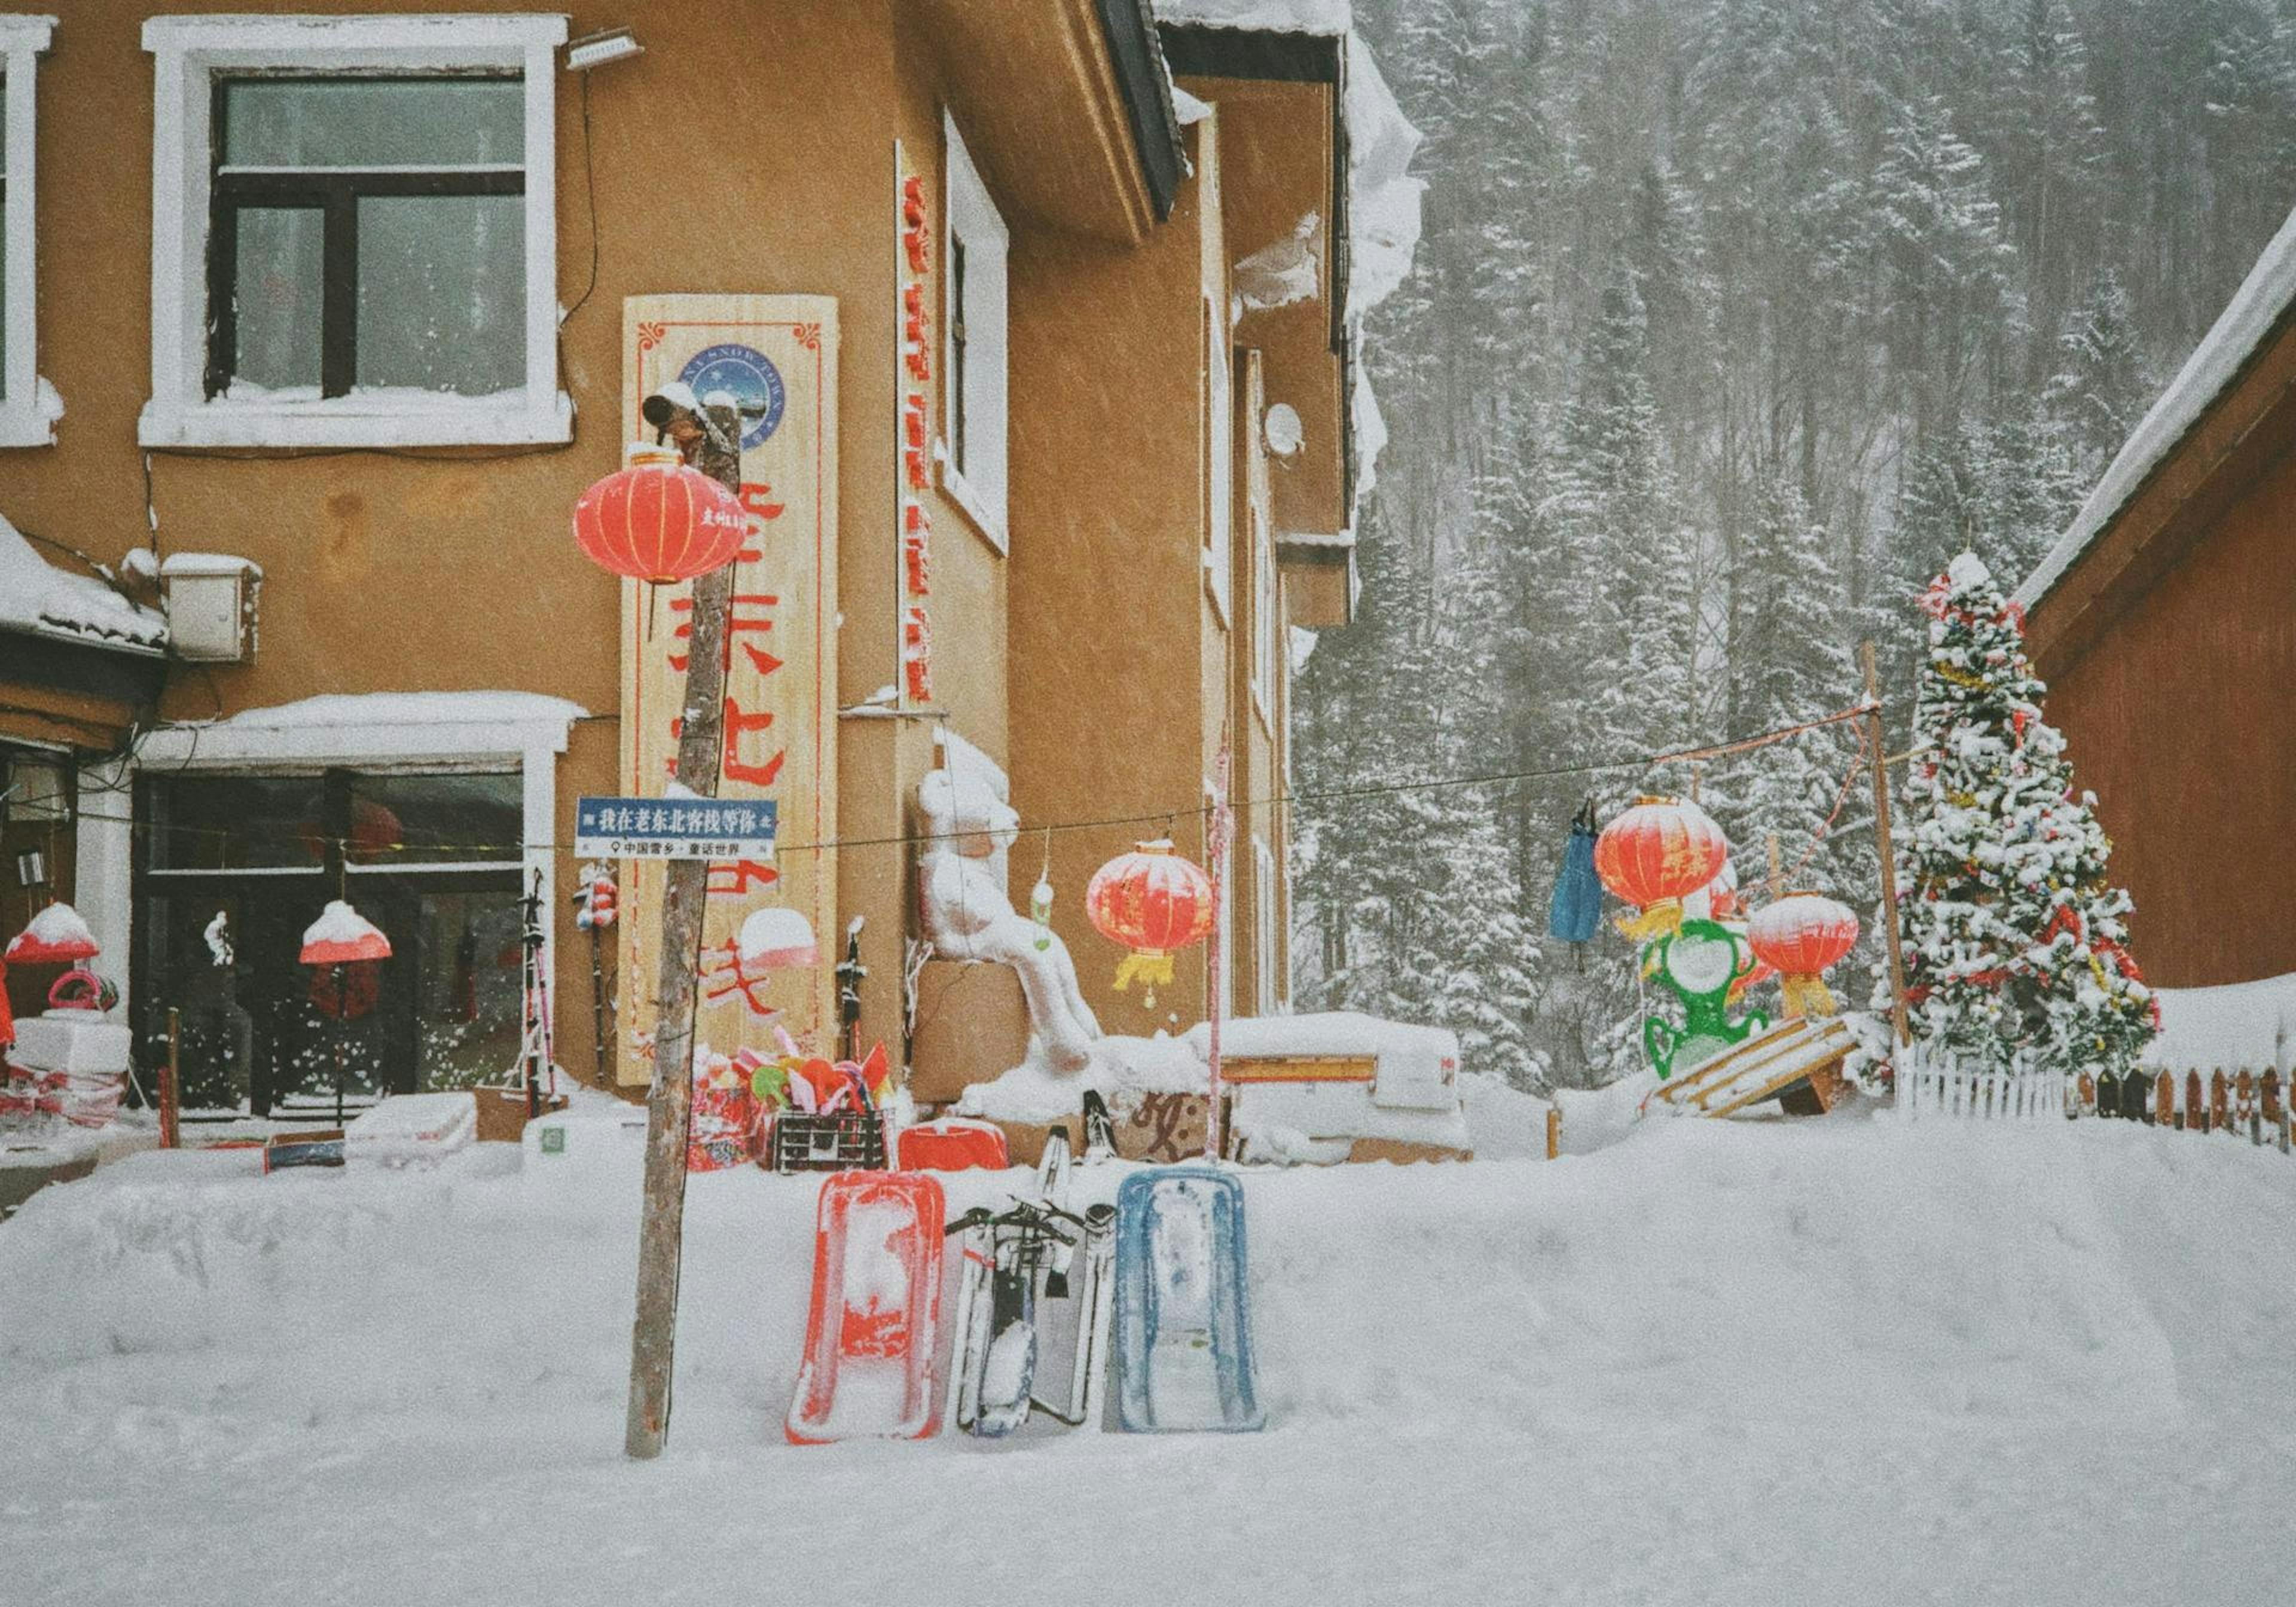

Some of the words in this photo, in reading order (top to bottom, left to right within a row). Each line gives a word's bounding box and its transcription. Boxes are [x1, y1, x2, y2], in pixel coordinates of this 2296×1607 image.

[624, 842, 674, 855] 中国雪乡
[689, 842, 740, 856] 童话世界
